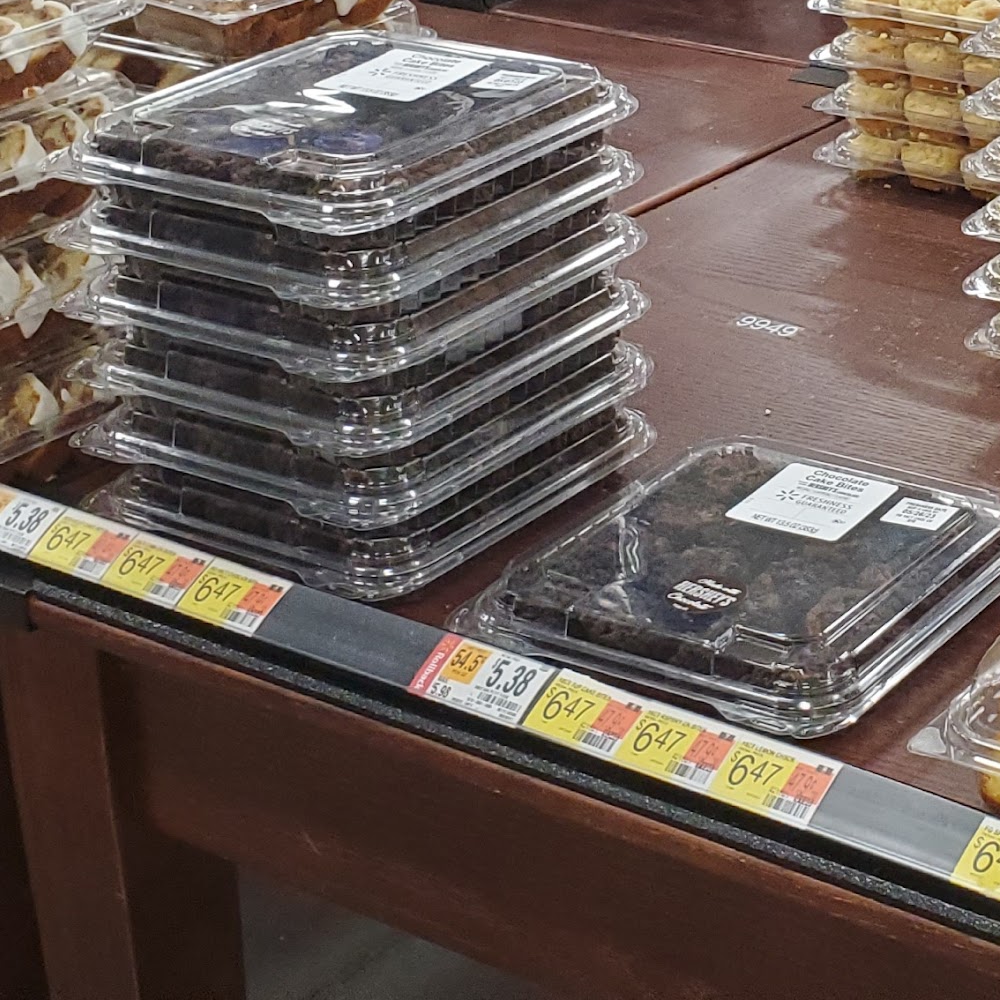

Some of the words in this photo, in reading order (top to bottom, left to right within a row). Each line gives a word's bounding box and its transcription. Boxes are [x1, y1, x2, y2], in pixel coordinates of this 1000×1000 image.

[736, 316, 799, 337] 9949
[805, 475, 833, 485] Cake
[835, 481, 864, 492] Bites
[814, 470, 870, 486] Chocolate
[795, 499, 847, 514] GUARANTEED
[801, 495, 853, 510] FRESHNESS
[752, 513, 764, 522] NET
[414, 652, 446, 690] Rollback
[430, 682, 452, 699] 5.98
